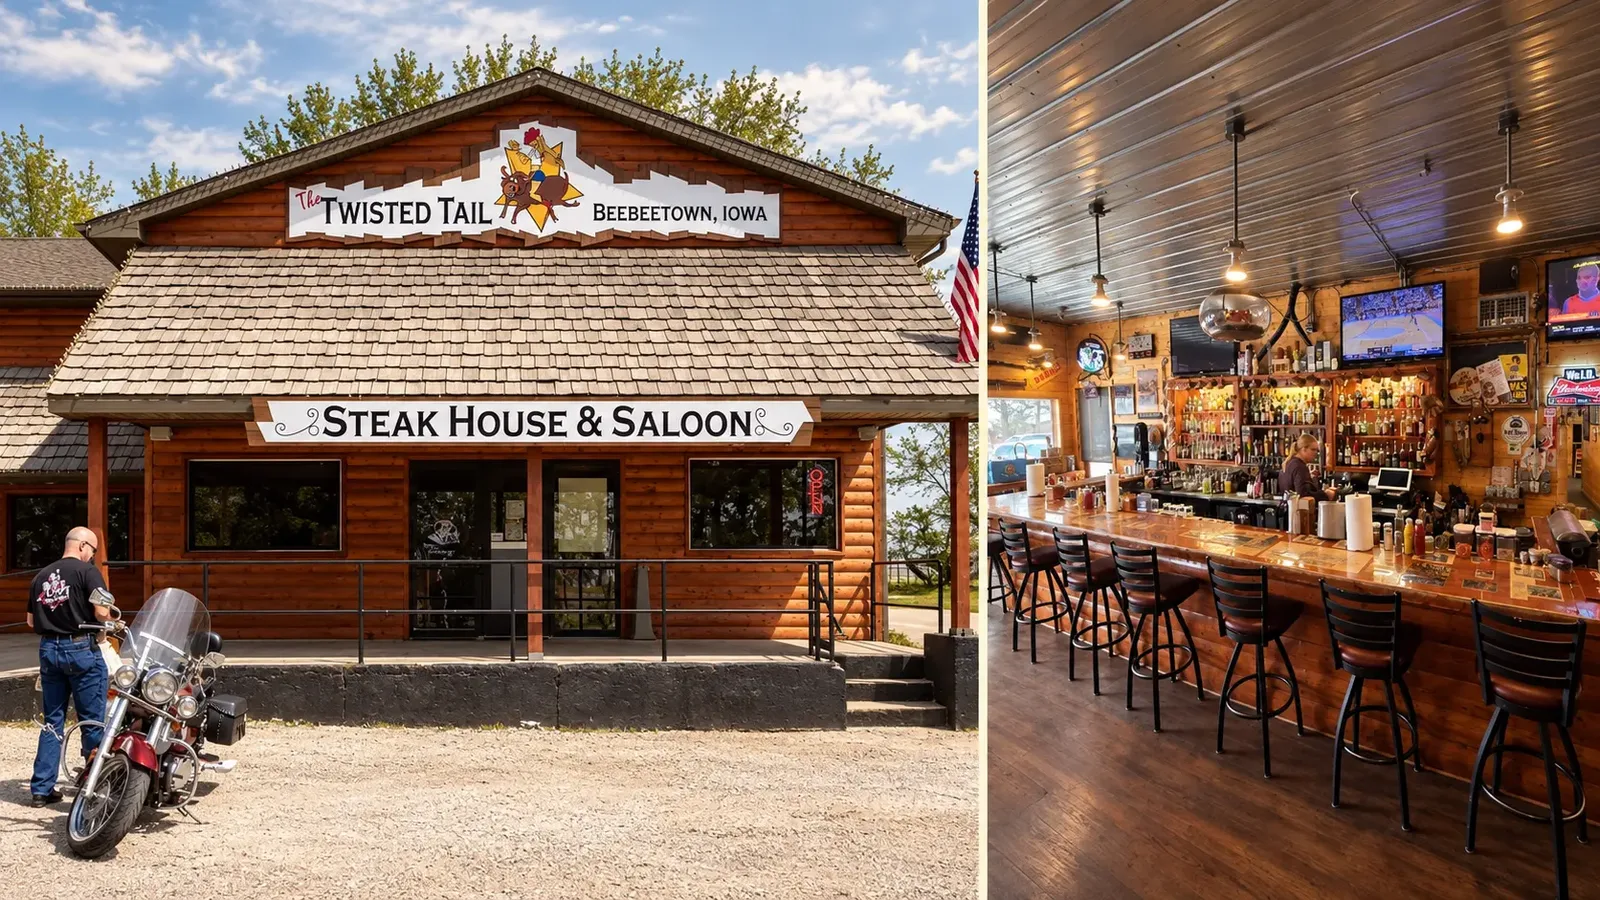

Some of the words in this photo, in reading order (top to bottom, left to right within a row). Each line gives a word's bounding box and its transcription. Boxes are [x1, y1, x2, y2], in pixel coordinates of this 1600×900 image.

[295, 189, 321, 210] The
[320, 196, 432, 225] TWISTED
[437, 196, 492, 225] TAIL
[593, 203, 717, 224] BEEBEETOWN,
[723, 206, 768, 222] IOWA
[322, 405, 439, 437] STEAK
[449, 405, 567, 437] HOUSE
[576, 405, 602, 437] &
[612, 405, 752, 437] SALOON
